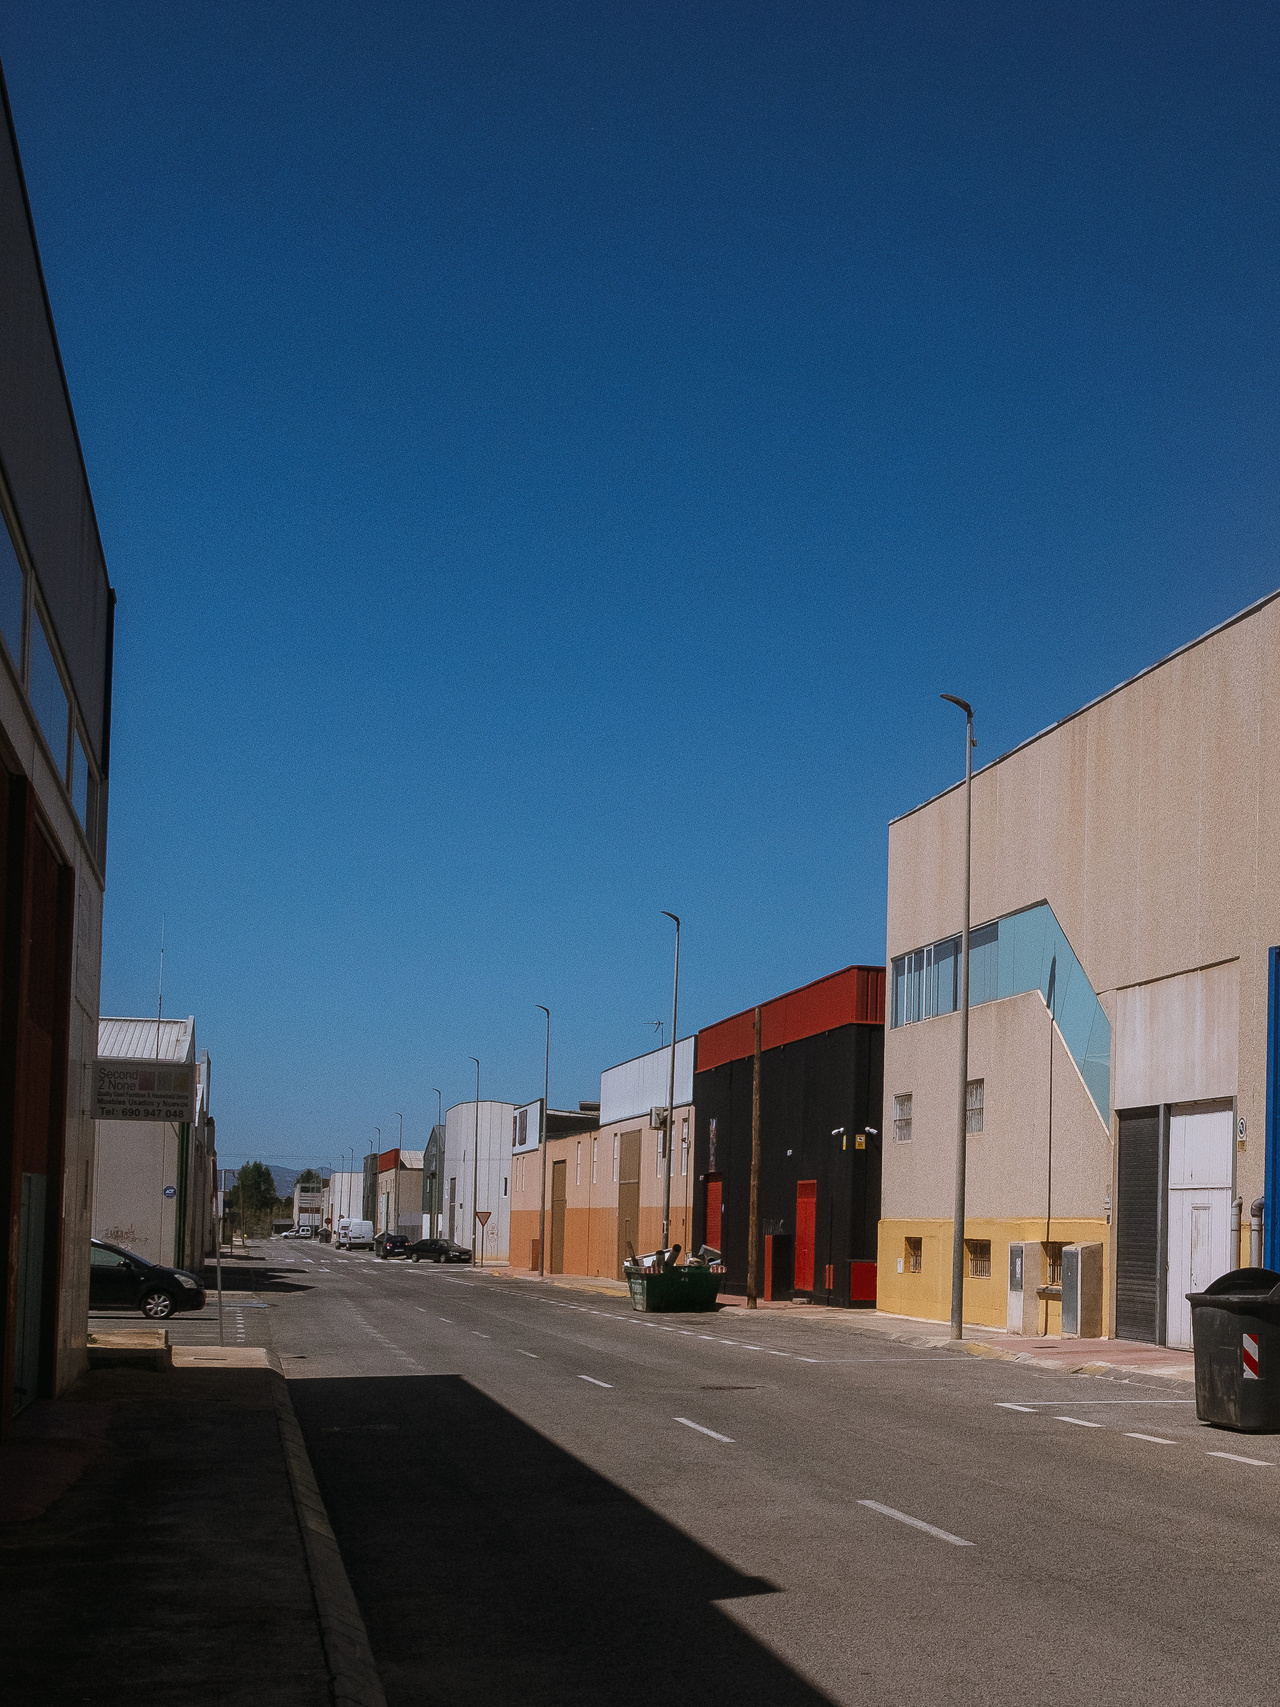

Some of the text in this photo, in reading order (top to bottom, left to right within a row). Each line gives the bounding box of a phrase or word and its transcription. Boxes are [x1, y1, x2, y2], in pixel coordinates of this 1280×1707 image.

[99, 1067, 138, 1080] Second
[98, 1079, 136, 1091] 2 None
[128, 1099, 155, 1107] Usados
[100, 1106, 184, 1119] Tel: 690 947 048
